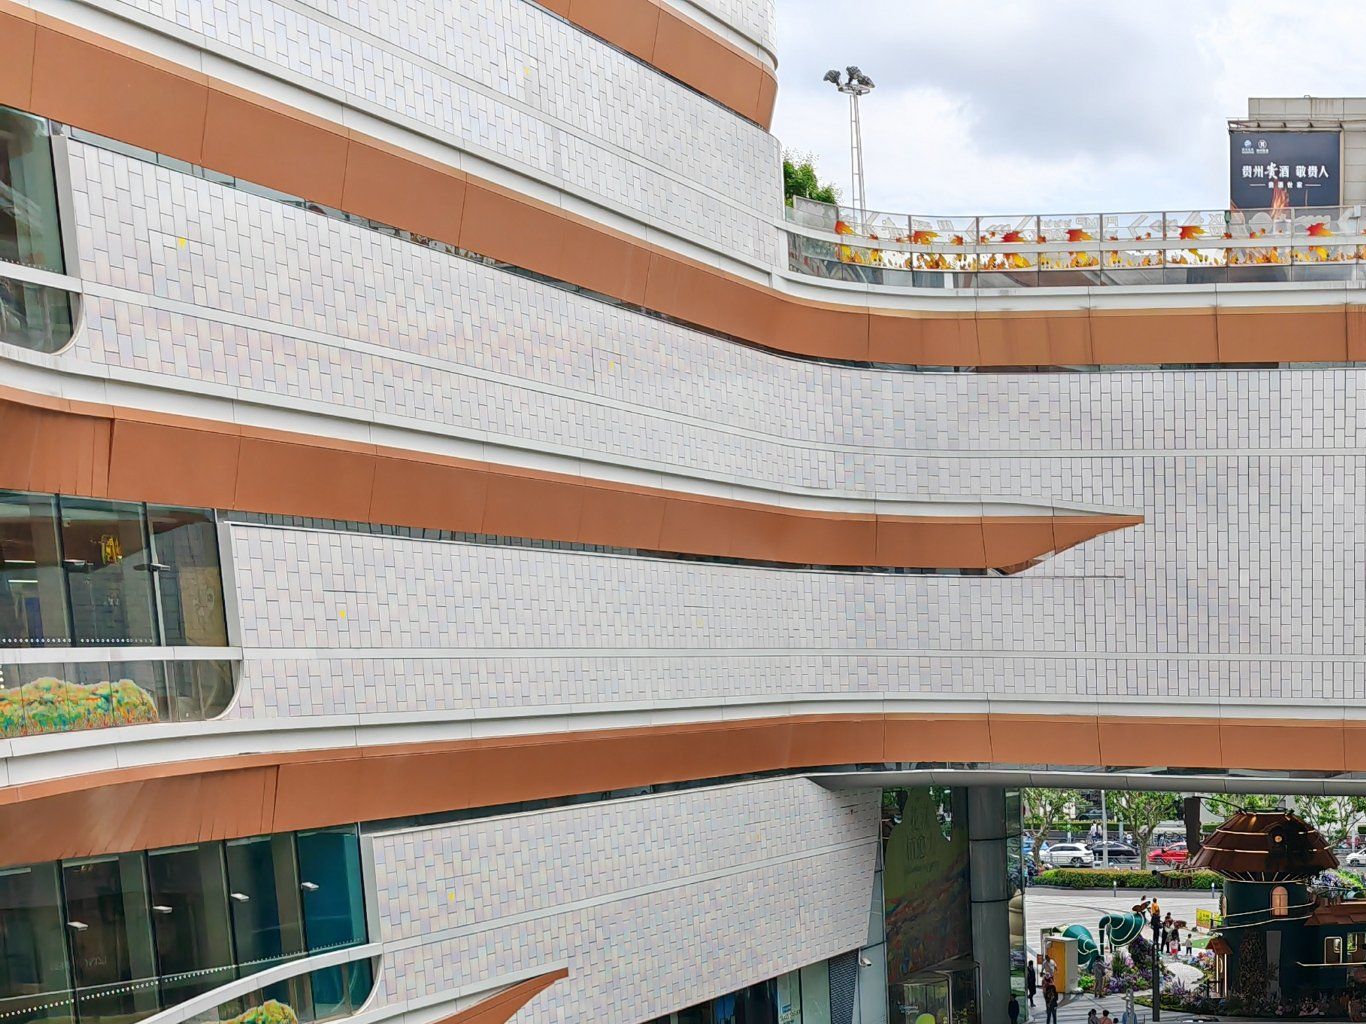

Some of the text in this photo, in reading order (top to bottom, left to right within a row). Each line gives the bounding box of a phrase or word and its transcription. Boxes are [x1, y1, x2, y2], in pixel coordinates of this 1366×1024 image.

[1242, 162, 1329, 179] 贵州贵酒 敬贵人
